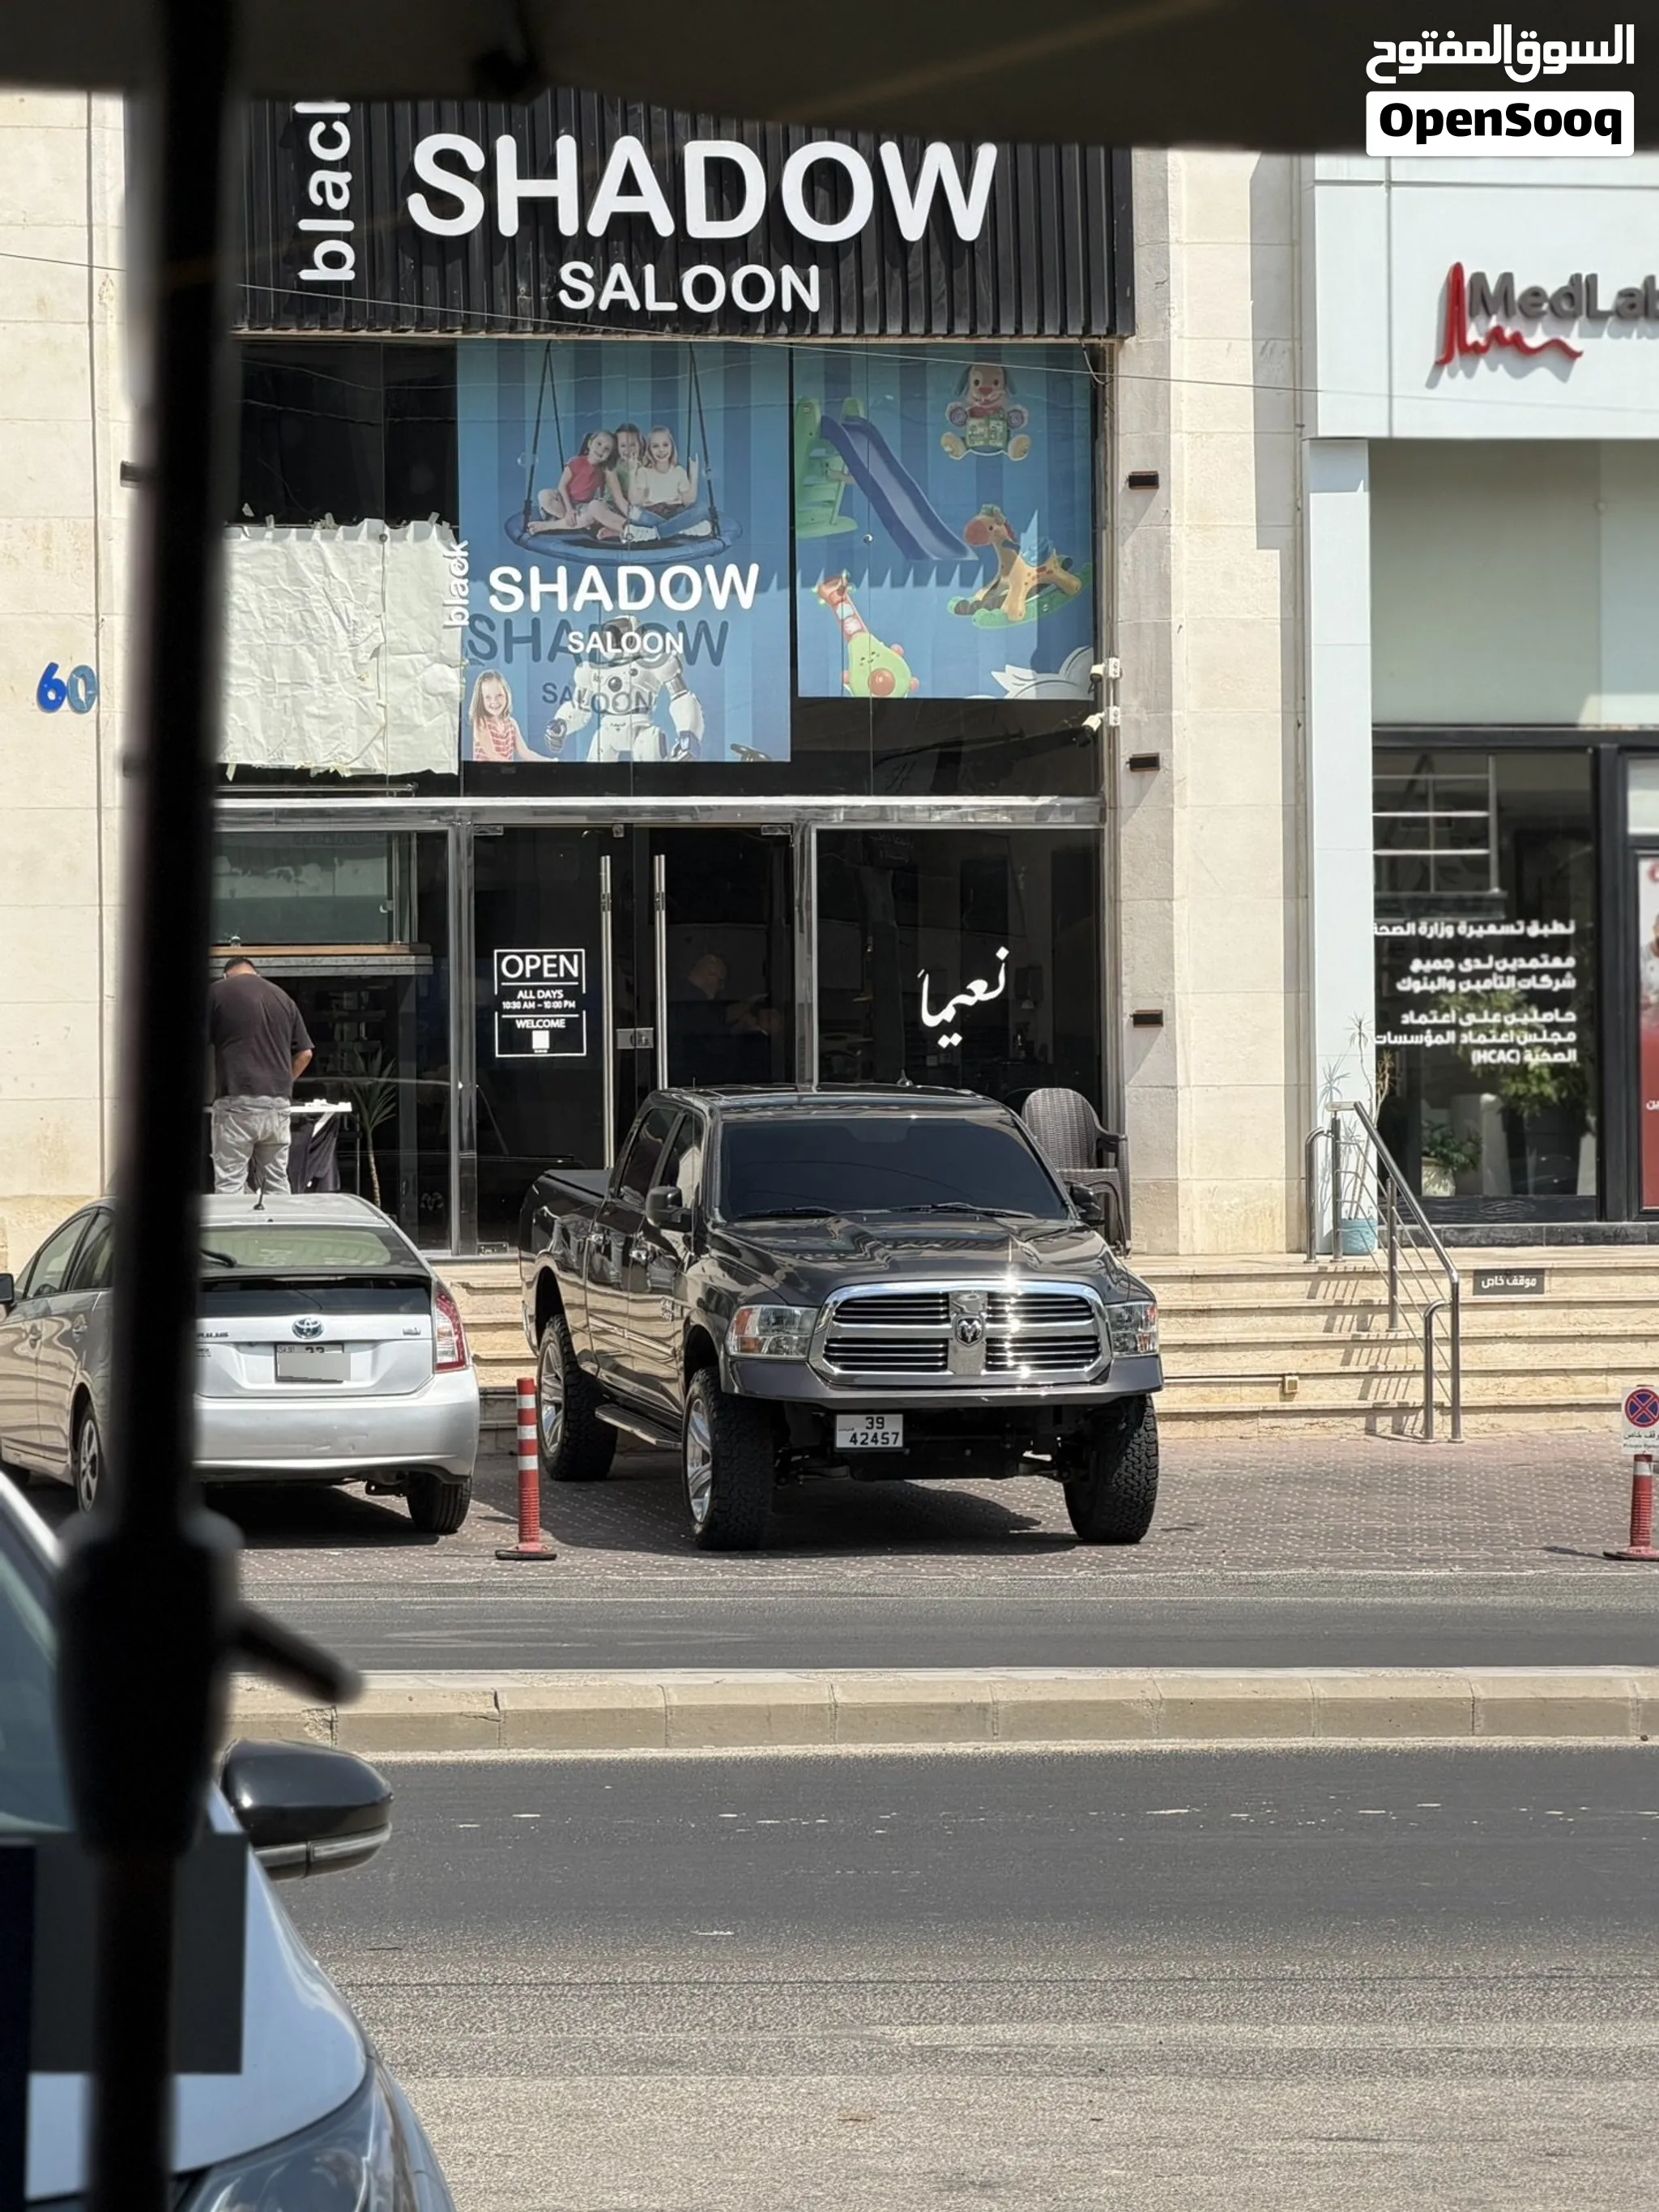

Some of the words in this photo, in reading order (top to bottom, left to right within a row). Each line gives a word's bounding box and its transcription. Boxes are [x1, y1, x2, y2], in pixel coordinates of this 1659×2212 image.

[406, 133, 998, 242] SHADOW
[557, 260, 821, 313] SALOON
[443, 540, 470, 629] black
[488, 563, 760, 613] SHADOW
[567, 631, 684, 654] SALOON
[36, 662, 98, 714] 60
[1418, 919, 1455, 939] وزارة
[1457, 919, 1525, 939] تسعيرة
[1526, 918, 1576, 937] نطبق
[501, 954, 579, 978] OPEN
[1410, 957, 1456, 974] جميع
[1458, 953, 1494, 973] لدى
[1495, 953, 1576, 972] معتمدين
[1396, 975, 1456, 994] والبنوك
[1458, 972, 1516, 992] التأمين
[1517, 971, 1576, 991] شركات
[517, 990, 535, 999] ALL
[537, 989, 565, 999] DAYS
[522, 1000, 535, 1009] AM
[515, 1018, 566, 1029] WELCOME
[1401, 1007, 1456, 1025] اعتماد
[1458, 1009, 1502, 1027] على
[1503, 1008, 1577, 1026] حاصلين
[1459, 1028, 1514, 1044] اعتماد
[1516, 1029, 1577, 1046] مجلس
[1471, 1049, 1521, 1066] (HCAC)
[1481, 1275, 1504, 1289] خاص
[1507, 1275, 1537, 1288] موقف
[864, 1416, 885, 1430] 39
[849, 1431, 900, 1446] 42457
